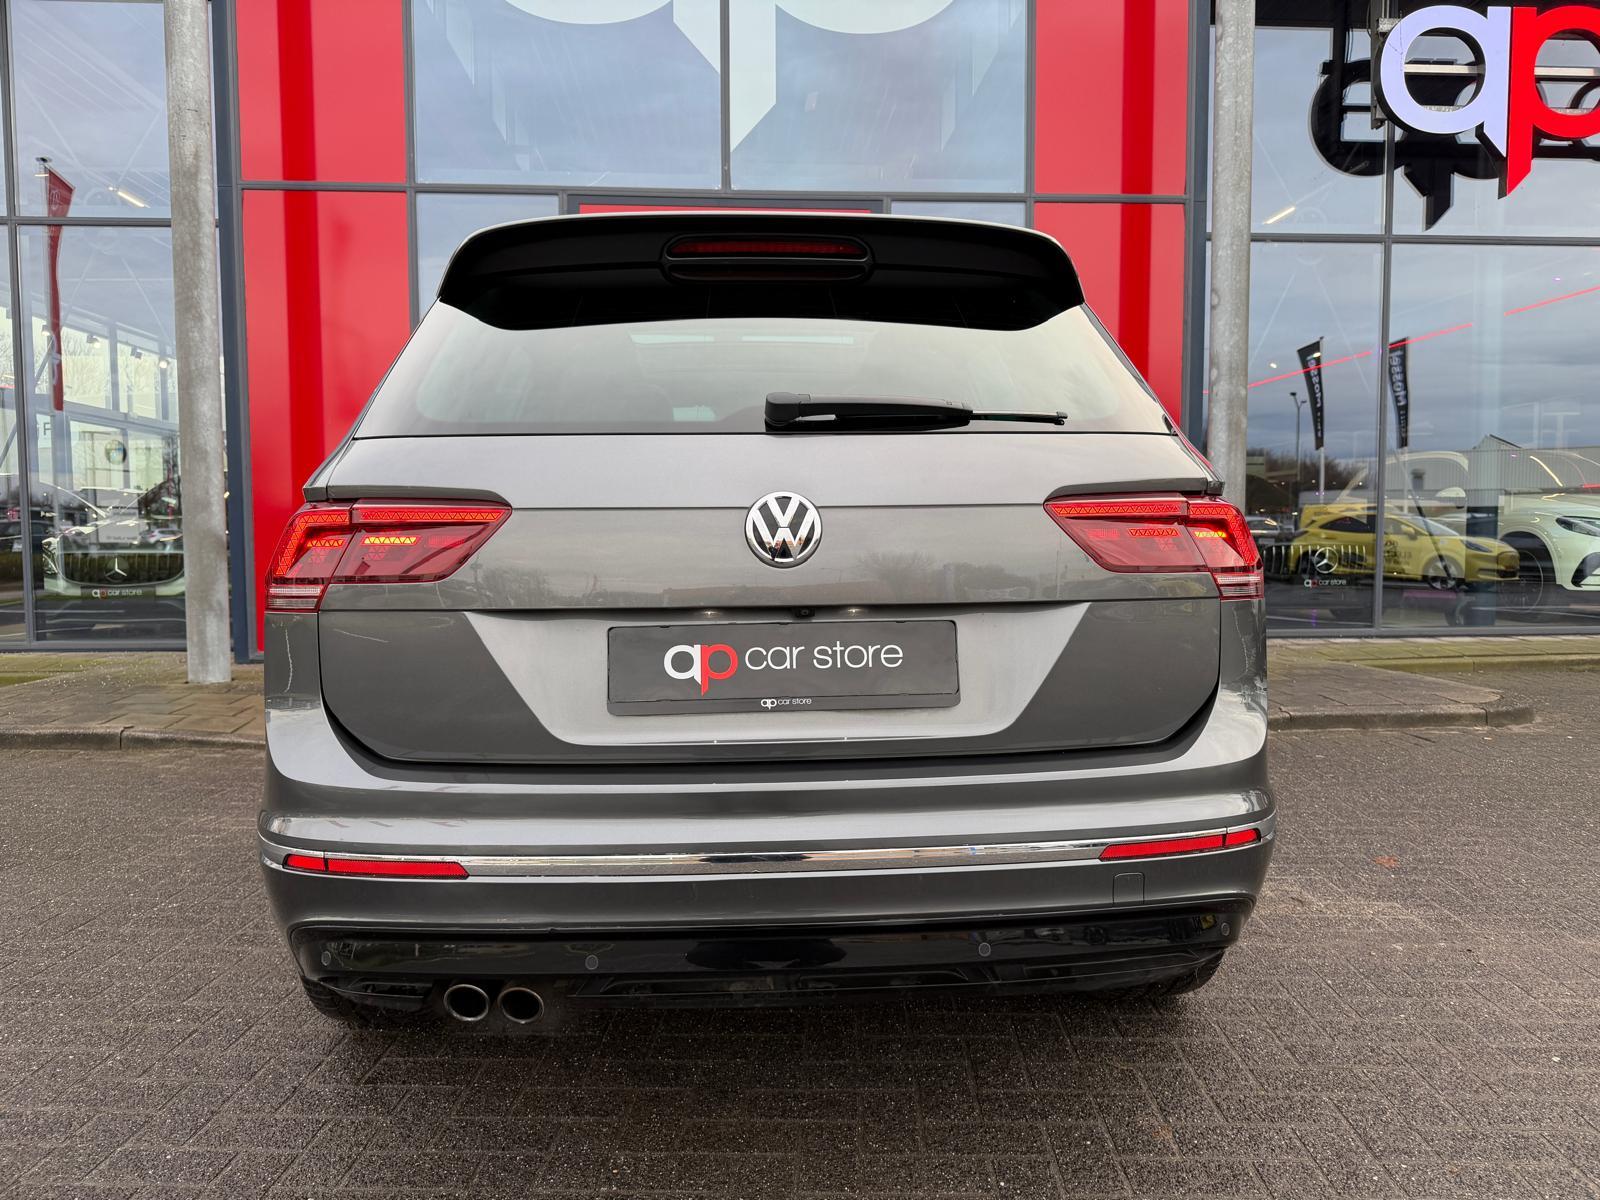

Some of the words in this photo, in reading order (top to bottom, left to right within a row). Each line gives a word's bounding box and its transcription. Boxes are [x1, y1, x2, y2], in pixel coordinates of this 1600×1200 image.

[744, 645, 806, 671] car
[812, 640, 904, 670] store
[791, 697, 812, 705] store
